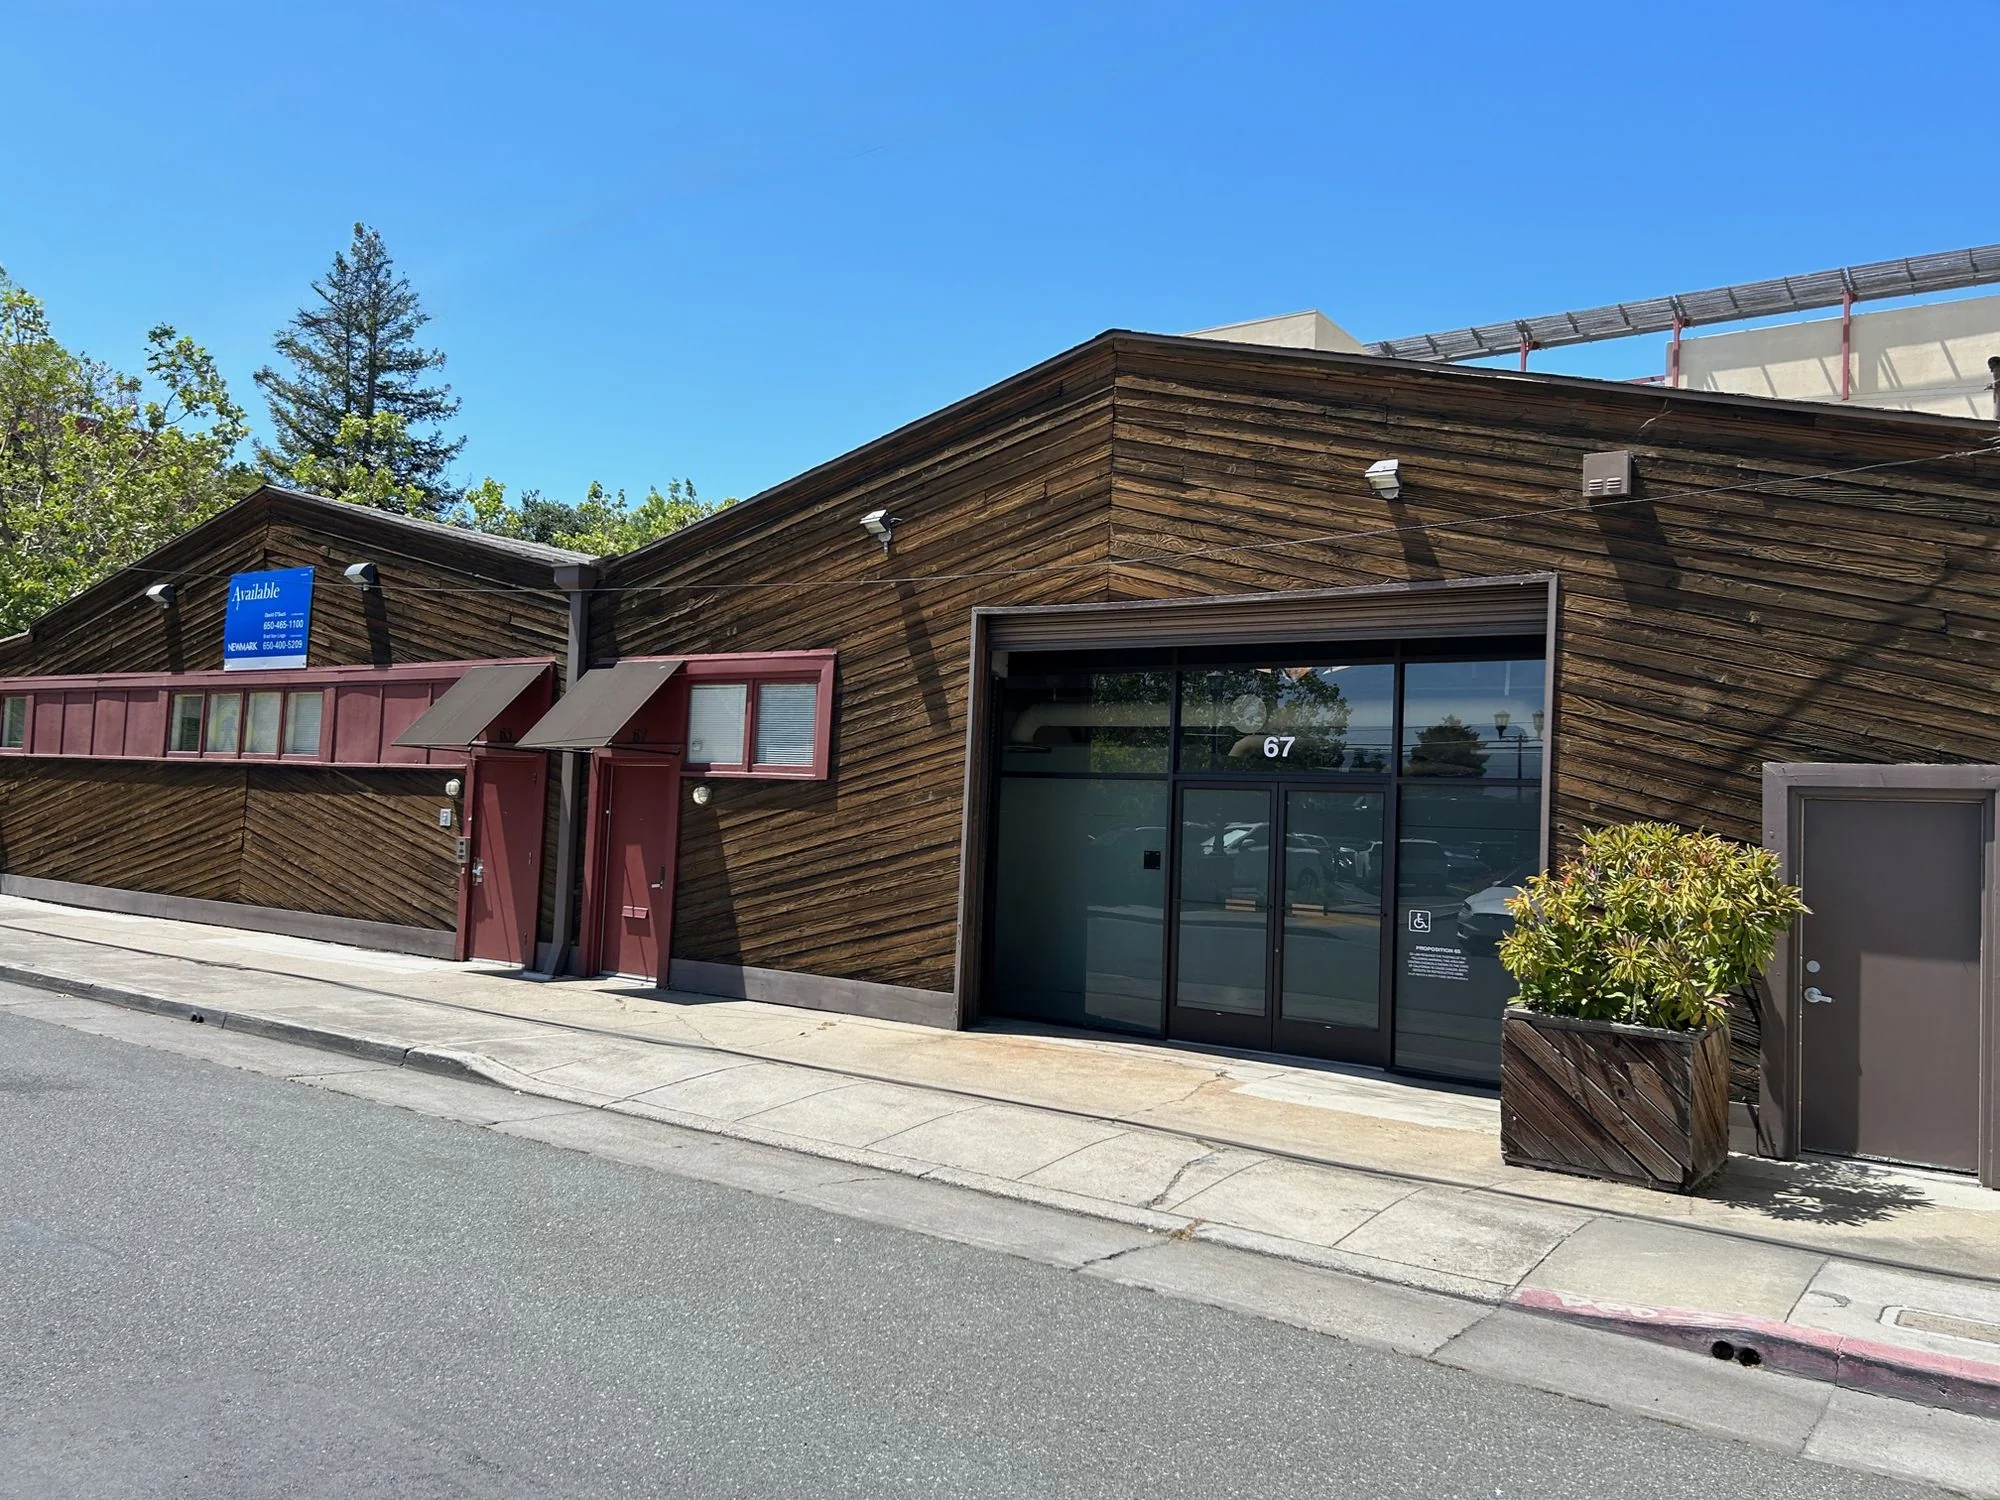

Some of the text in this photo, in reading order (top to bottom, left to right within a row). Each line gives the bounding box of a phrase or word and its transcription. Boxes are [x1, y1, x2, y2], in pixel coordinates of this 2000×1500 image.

[232, 582, 280, 610] Available
[263, 619, 304, 630] 650-465-1100
[228, 641, 258, 652] NEWMARK
[263, 639, 303, 650] 650-400-5209
[1264, 736, 1296, 757] 67
[1415, 945, 1454, 953] PROPOSITION
